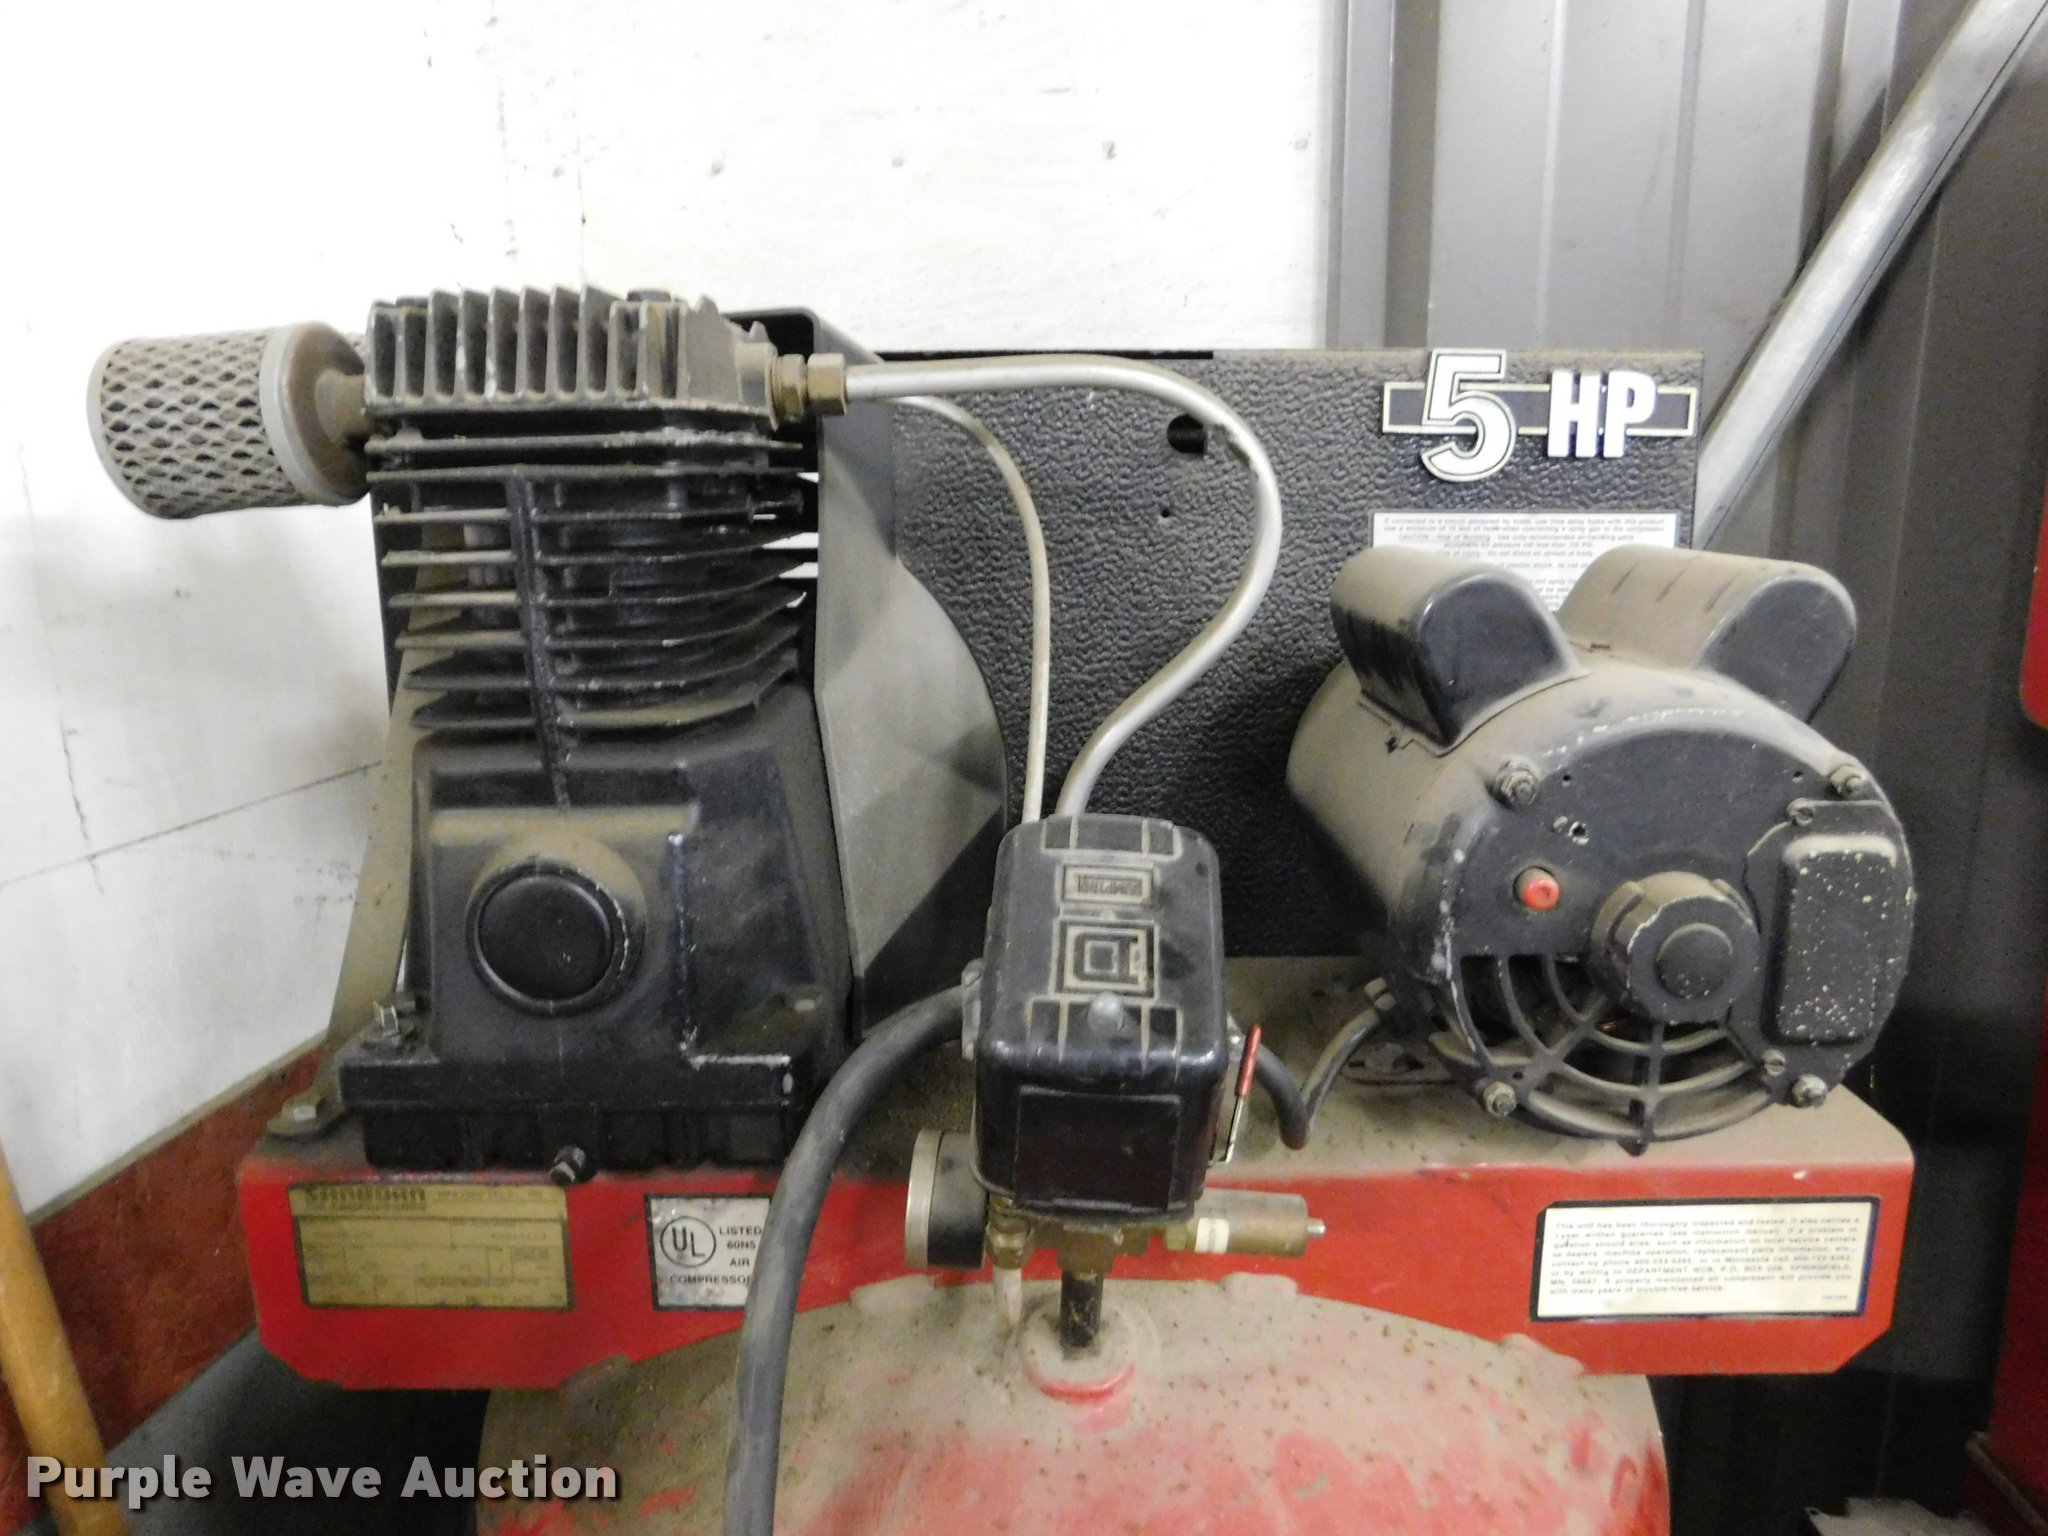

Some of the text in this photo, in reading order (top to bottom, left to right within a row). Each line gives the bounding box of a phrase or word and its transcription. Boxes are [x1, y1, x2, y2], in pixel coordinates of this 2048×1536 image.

[1421, 348, 1657, 482] 5 HP
[719, 1226, 762, 1236] LISTED
[671, 1226, 706, 1257] UL
[729, 1257, 750, 1267] AIR
